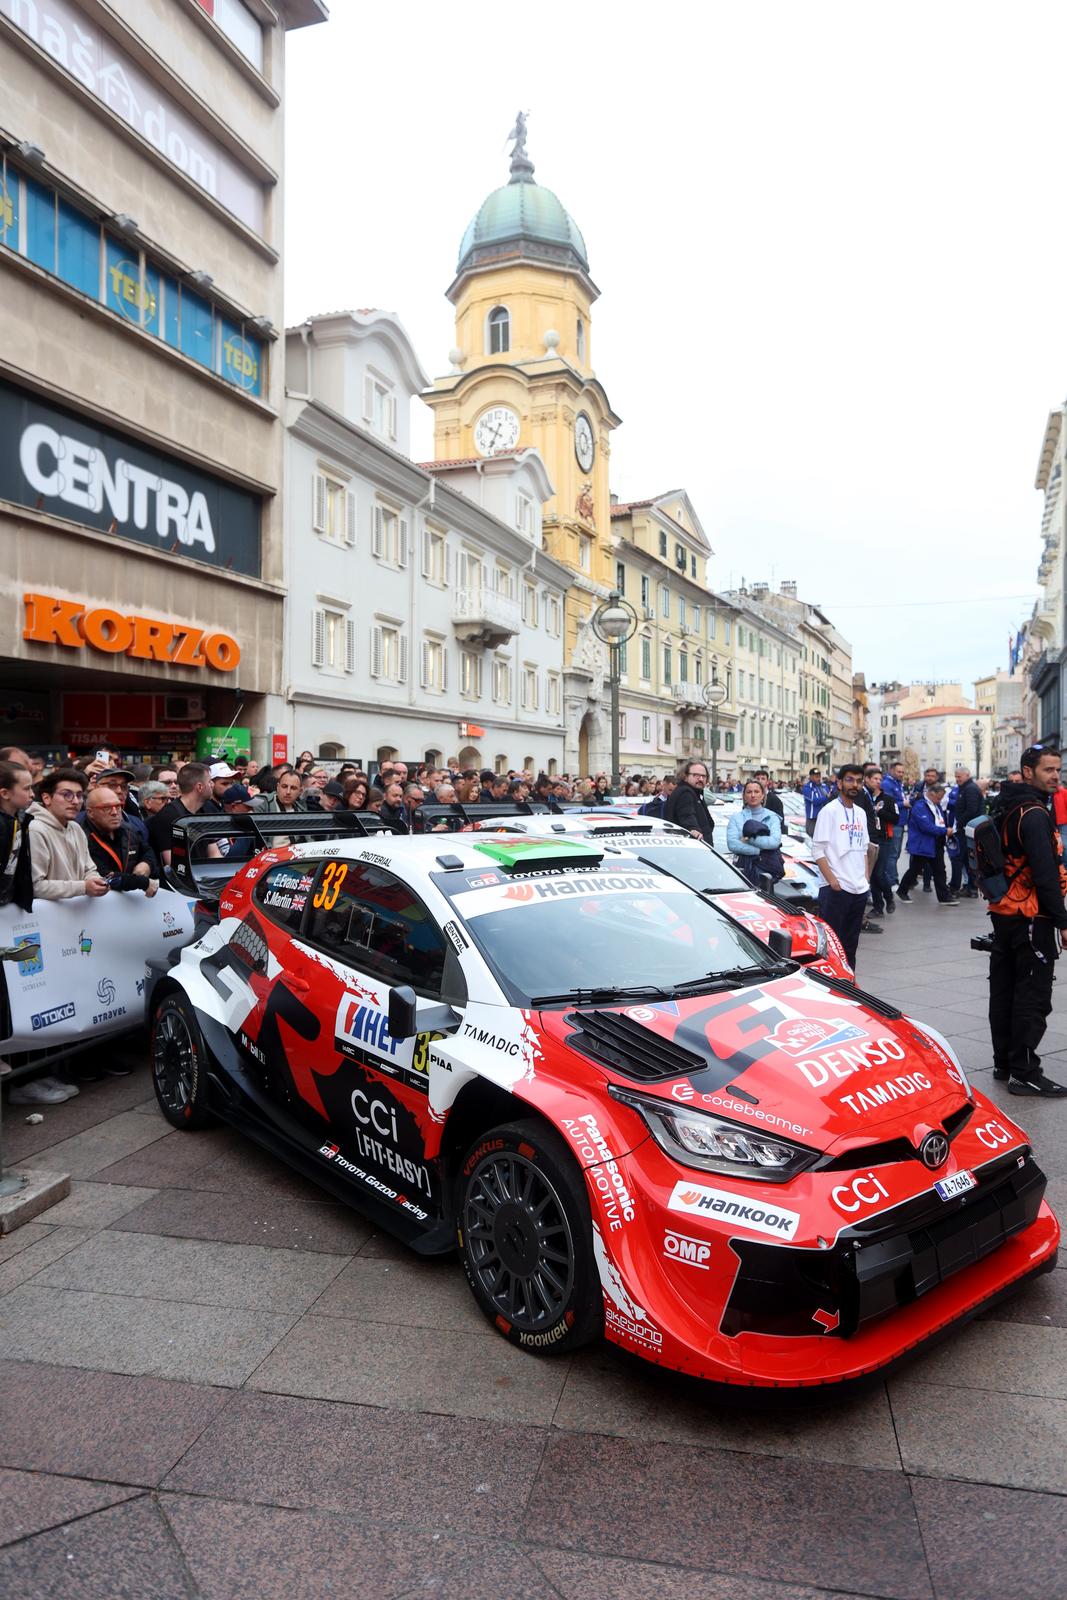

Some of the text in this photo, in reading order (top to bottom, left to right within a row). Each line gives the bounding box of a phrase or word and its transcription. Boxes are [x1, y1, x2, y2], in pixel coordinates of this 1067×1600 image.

[144, 104, 216, 198] dom
[20, 423, 216, 554] CENTRA
[23, 593, 241, 672] KORZO
[360, 851, 392, 867] PROTERIAL
[501, 869, 561, 881] TOYOTA
[563, 866, 609, 876] GAZOO
[264, 891, 292, 909] S.Martin
[273, 873, 299, 890] E.Evans
[313, 862, 348, 910] 33
[534, 877, 661, 897] Hankook
[445, 921, 463, 954] CENTRAL
[42, 1003, 74, 1026] TOKIĆ
[464, 1023, 520, 1056] TAMADIC
[430, 1054, 453, 1072] PIAA
[794, 1038, 905, 1088] DENSO
[839, 1072, 932, 1115] TAMADIC
[350, 1089, 398, 1142] CCi
[701, 1092, 809, 1137] codebeamer
[975, 1120, 1013, 1149] CCi
[560, 1119, 622, 1232] AUTOMOTIVE
[578, 1114, 635, 1222] Panasonic
[944, 1174, 971, 1195] A-7646
[335, 1155, 366, 1178] TOYOTA
[365, 1176, 397, 1198] GAZOO
[396, 1195, 428, 1220] Racing
[831, 1172, 890, 1213] CCi
[697, 1195, 794, 1232] Hankook
[663, 1237, 711, 1263] OMP
[520, 1322, 568, 1347] Hankook
[605, 1307, 663, 1344] akebono
